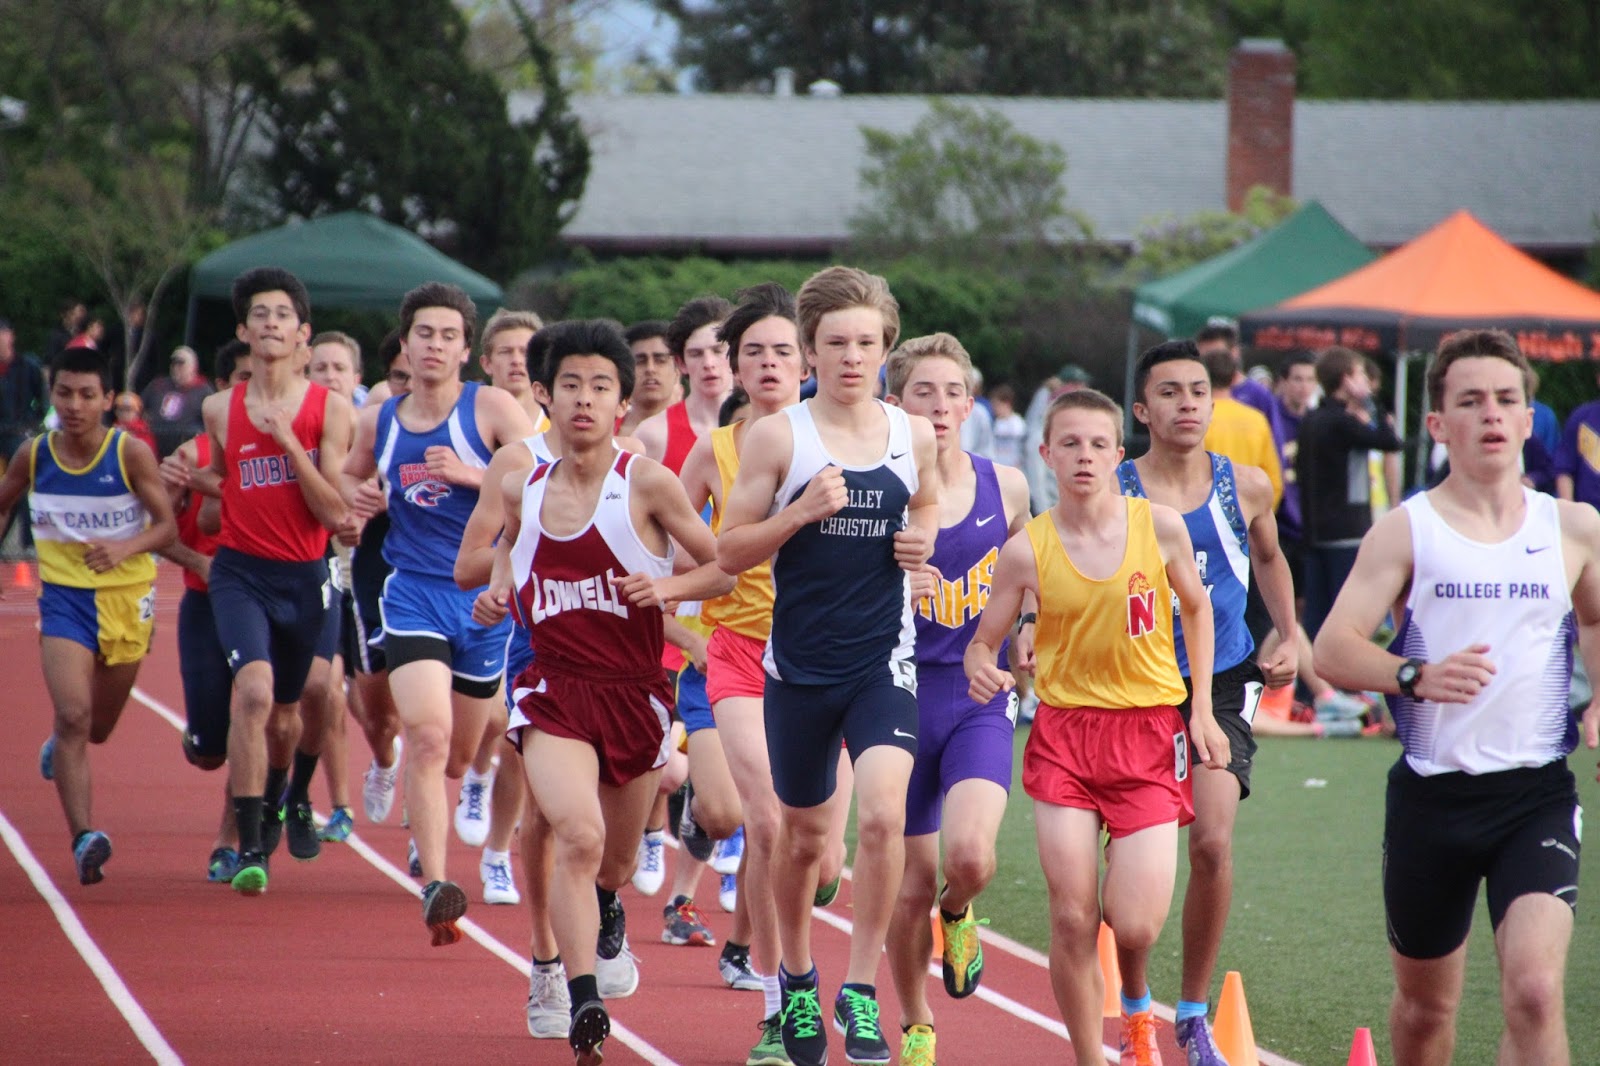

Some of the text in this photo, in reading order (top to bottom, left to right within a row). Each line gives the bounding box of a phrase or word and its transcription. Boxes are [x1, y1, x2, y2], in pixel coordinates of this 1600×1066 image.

[844, 489, 884, 509] LLEY
[64, 507, 135, 528] CAMPO
[820, 517, 889, 537] CHRISTIAN
[531, 568, 628, 625] LOWELL
[1435, 583, 1550, 599] COLLEGE PARK
[1127, 588, 1156, 639] N
